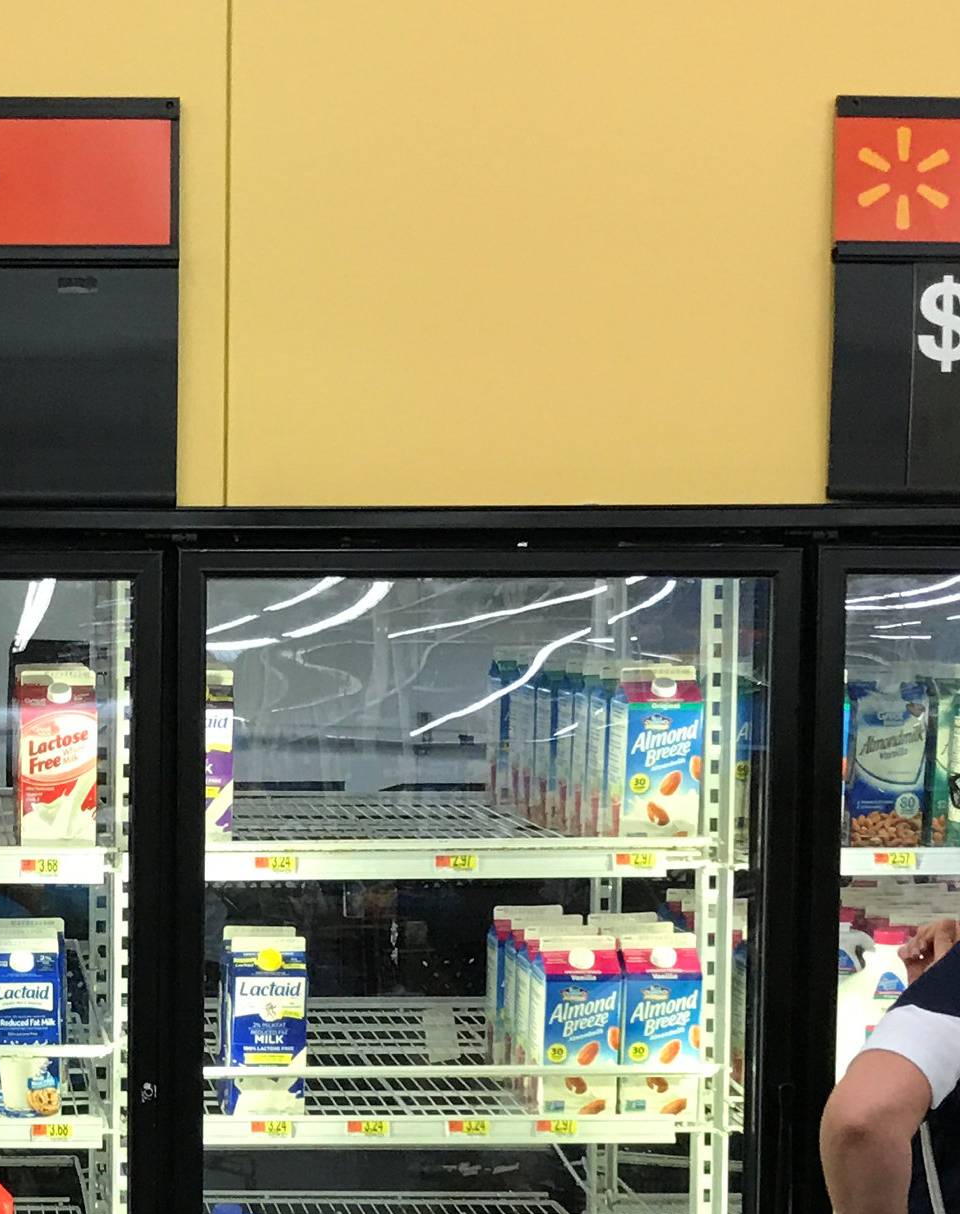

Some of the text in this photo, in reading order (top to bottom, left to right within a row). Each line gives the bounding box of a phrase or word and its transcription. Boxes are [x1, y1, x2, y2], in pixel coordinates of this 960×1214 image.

[28, 729, 89, 757] Lactose
[630, 720, 700, 755] Almond
[28, 755, 62, 775] Free
[645, 741, 692, 768] Breeze
[38, 859, 59, 873] 3.68
[239, 981, 302, 997] Lactaid
[548, 990, 618, 1025] Almond
[629, 988, 699, 1024] Almond
[0, 1018, 29, 1027] Reduced
[30, 1018, 40, 1027] Fat
[40, 1018, 56, 1027] Milk
[562, 1012, 609, 1038] Breeze
[643, 1010, 691, 1037] Breeze
[254, 1034, 284, 1044] MILK
